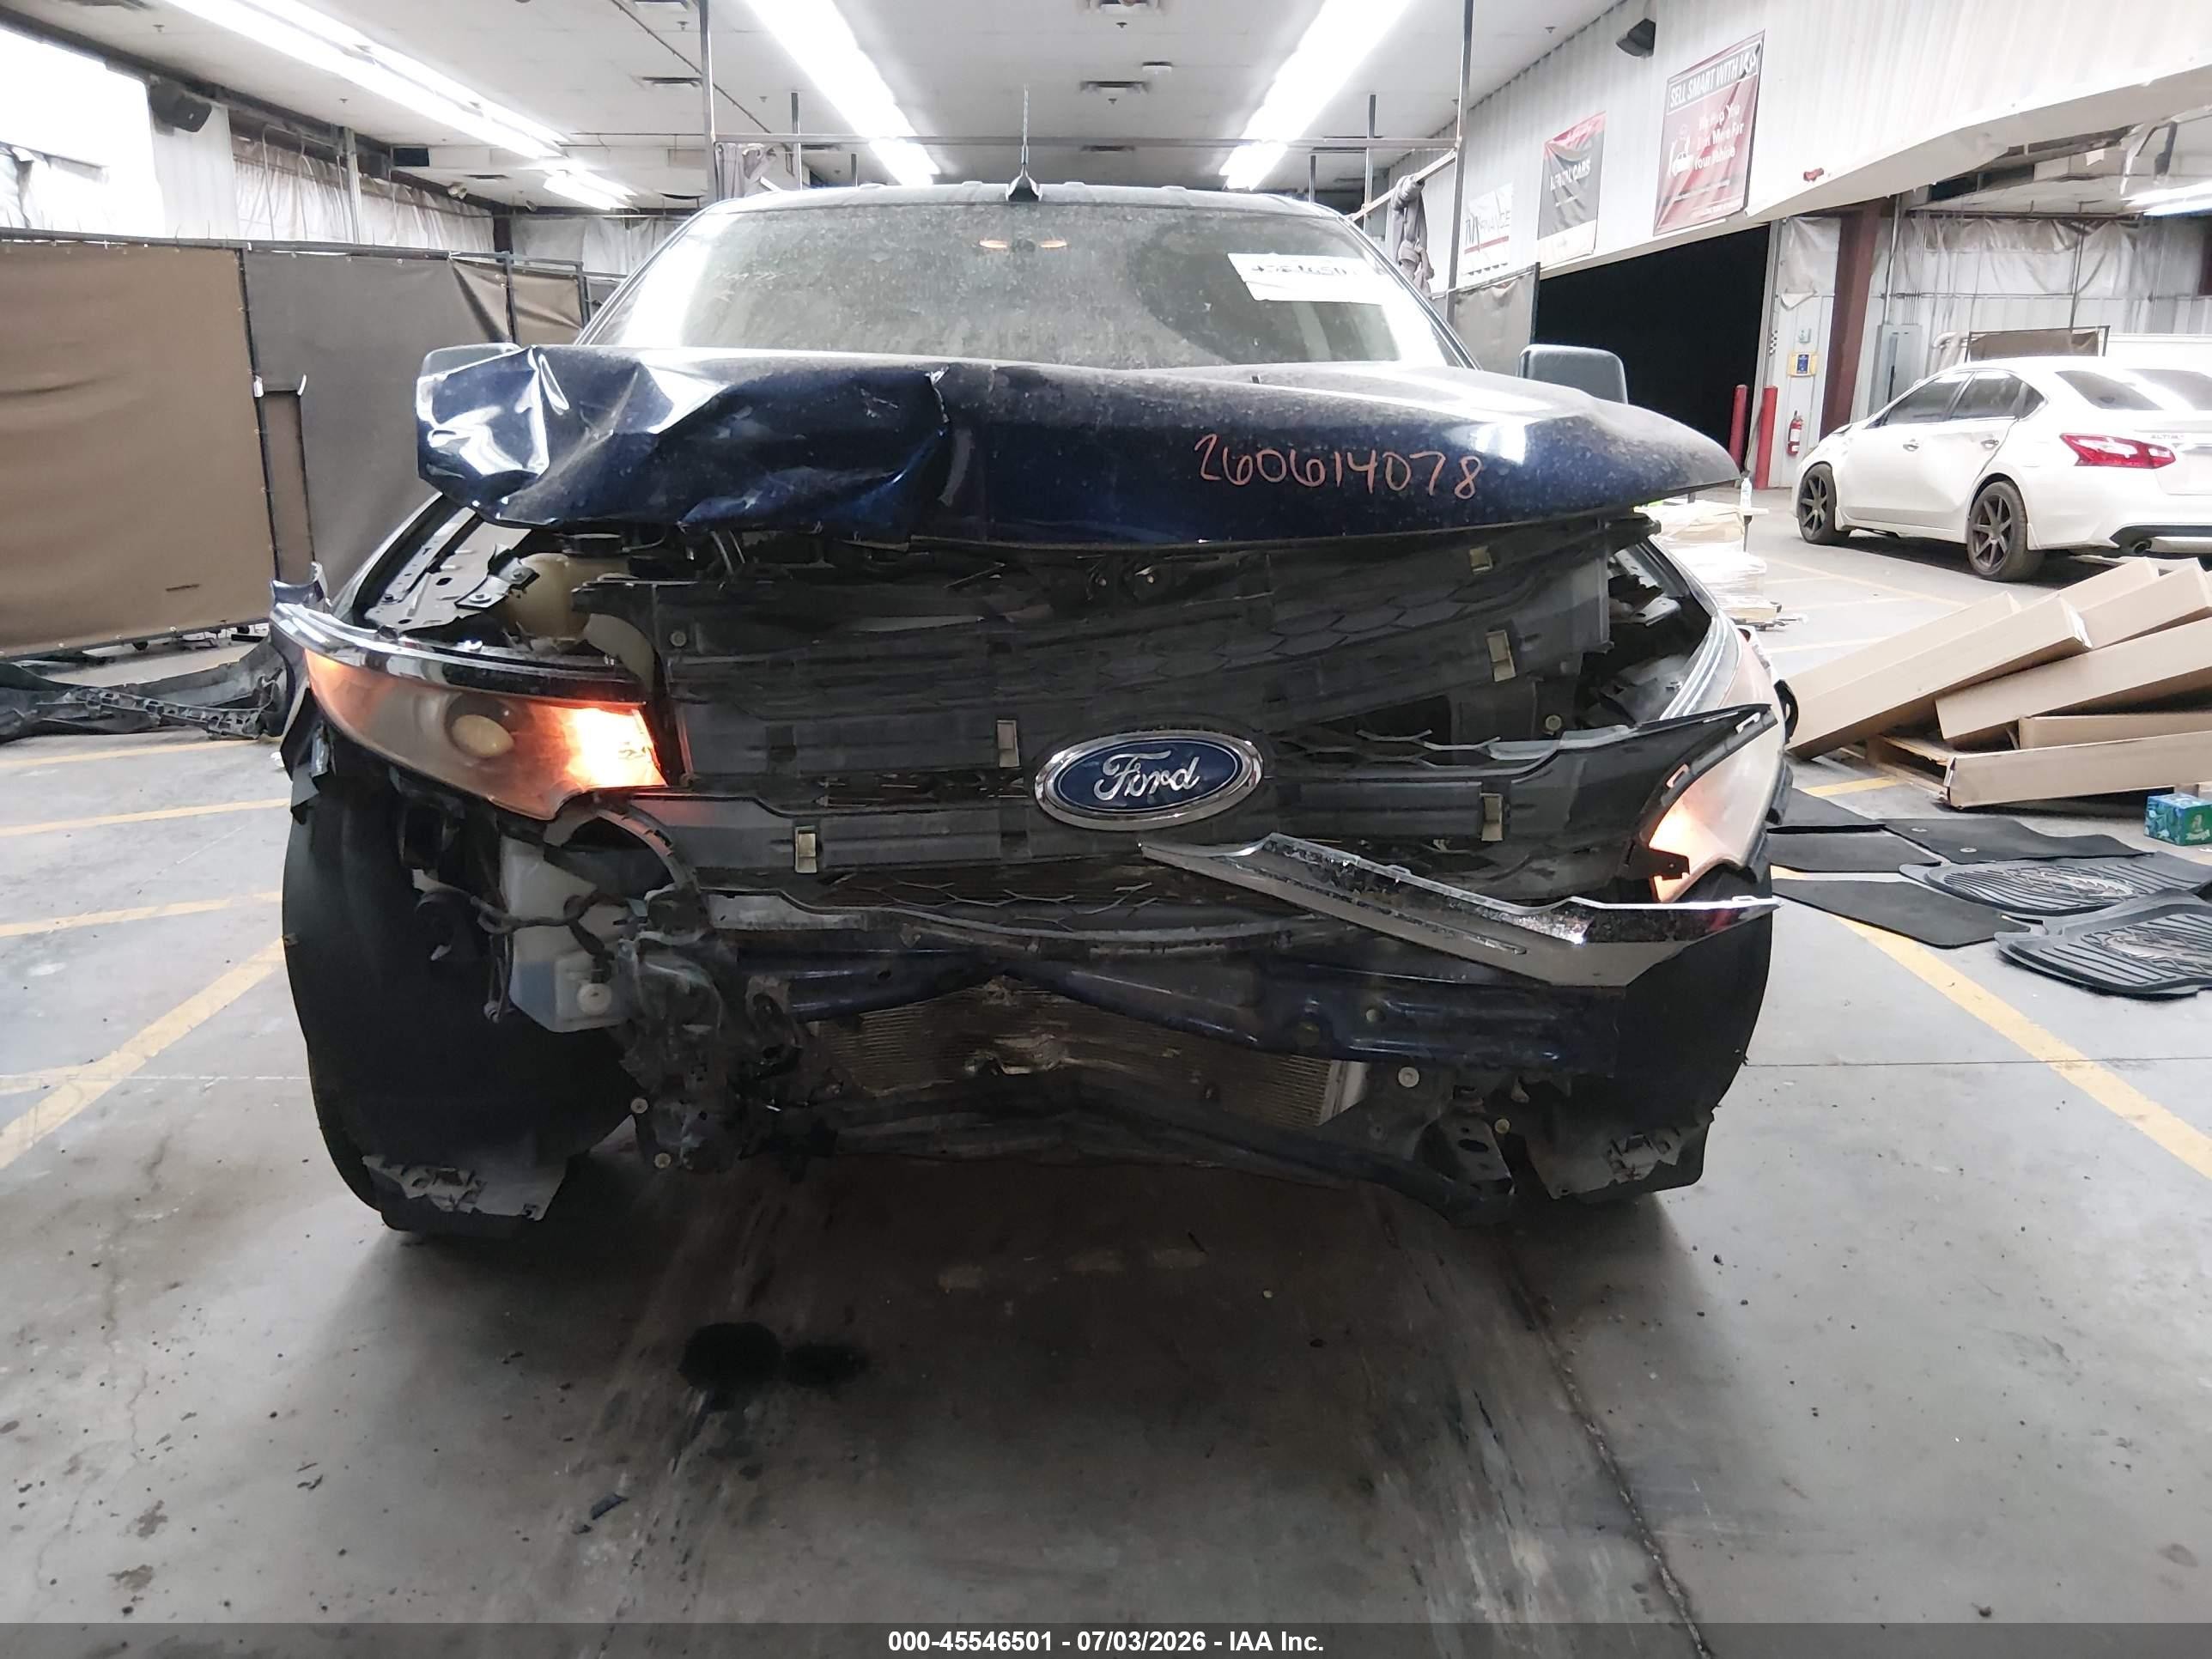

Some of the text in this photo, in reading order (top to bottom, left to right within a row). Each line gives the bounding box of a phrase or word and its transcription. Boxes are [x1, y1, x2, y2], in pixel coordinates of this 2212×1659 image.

[1670, 83, 1686, 108] SELL
[1686, 68, 1716, 100] SMART
[1717, 56, 1739, 88] WITH
[1194, 432, 1483, 501] 260614078
[1093, 749, 1200, 802] Ford
